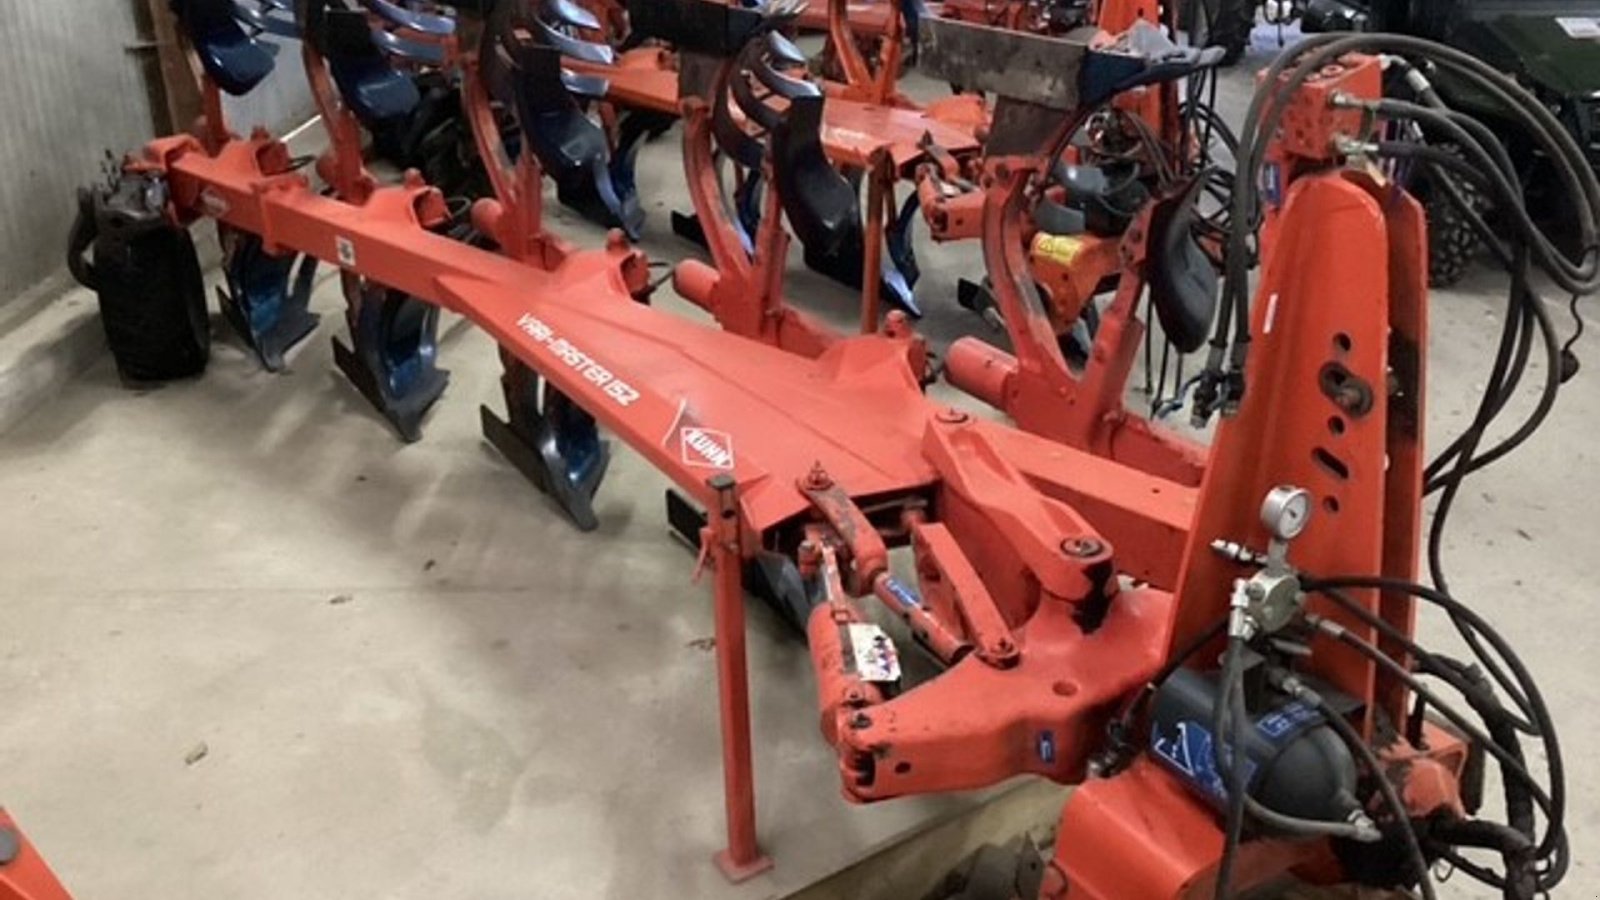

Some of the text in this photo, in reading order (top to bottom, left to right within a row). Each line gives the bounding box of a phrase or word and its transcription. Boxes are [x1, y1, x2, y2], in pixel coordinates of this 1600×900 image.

[516, 312, 640, 406] VARI-MASTER 152
[686, 429, 730, 466] KUHN
